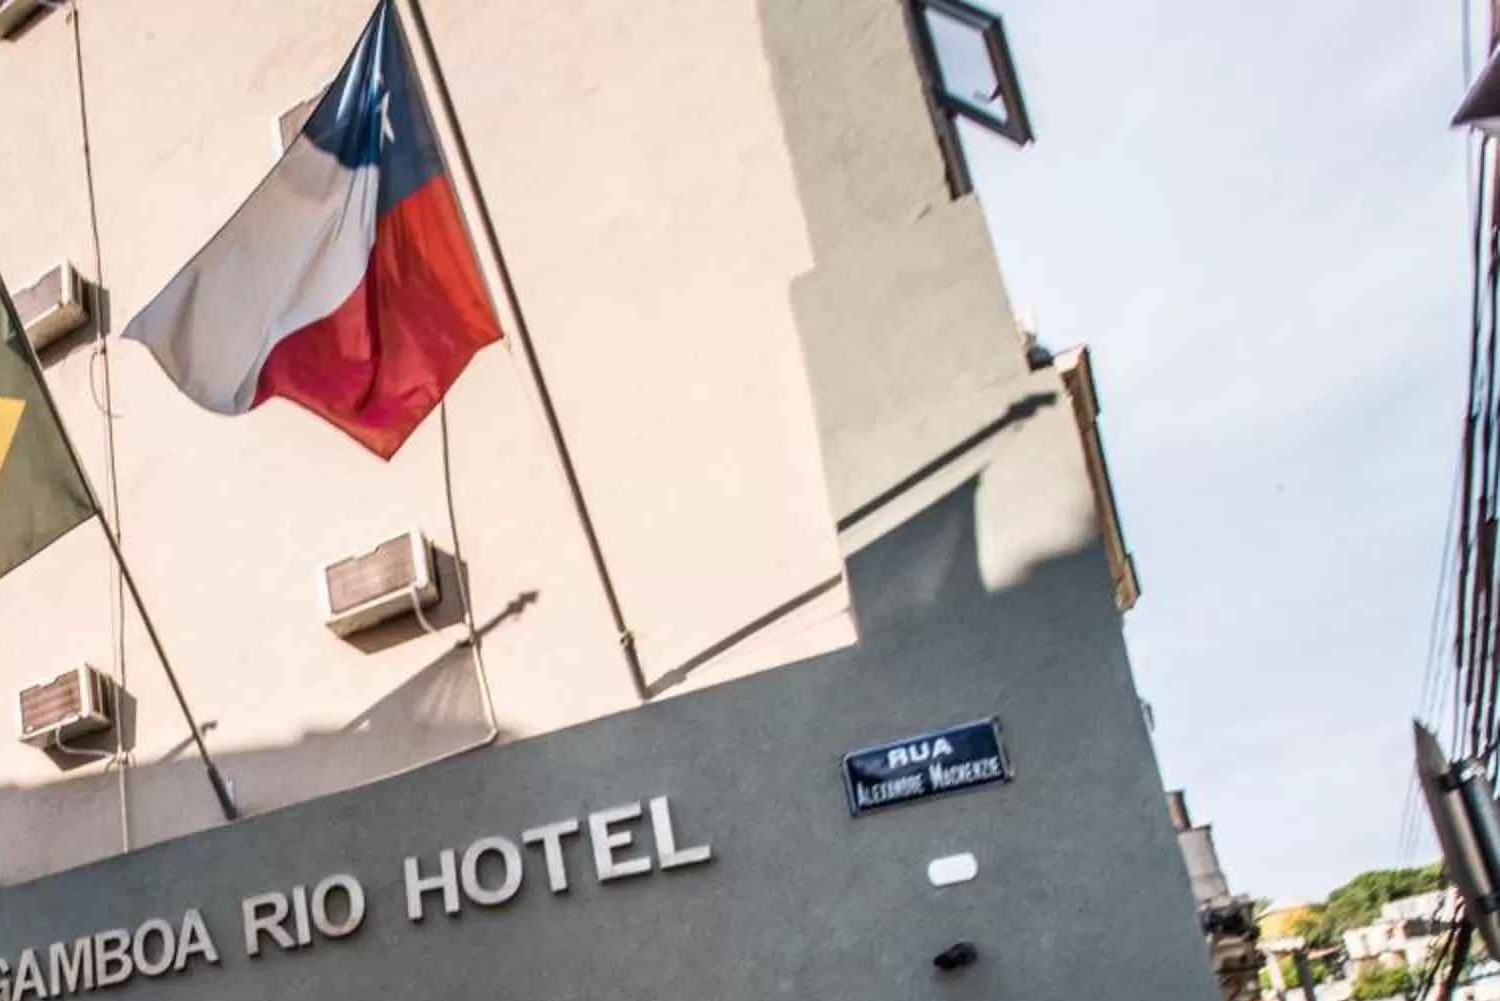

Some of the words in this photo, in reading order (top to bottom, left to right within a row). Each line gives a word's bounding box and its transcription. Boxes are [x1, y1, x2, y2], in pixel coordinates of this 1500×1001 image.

[887, 736, 954, 769] RUA
[241, 873, 366, 956] RIO
[403, 795, 712, 922] HOTEL
